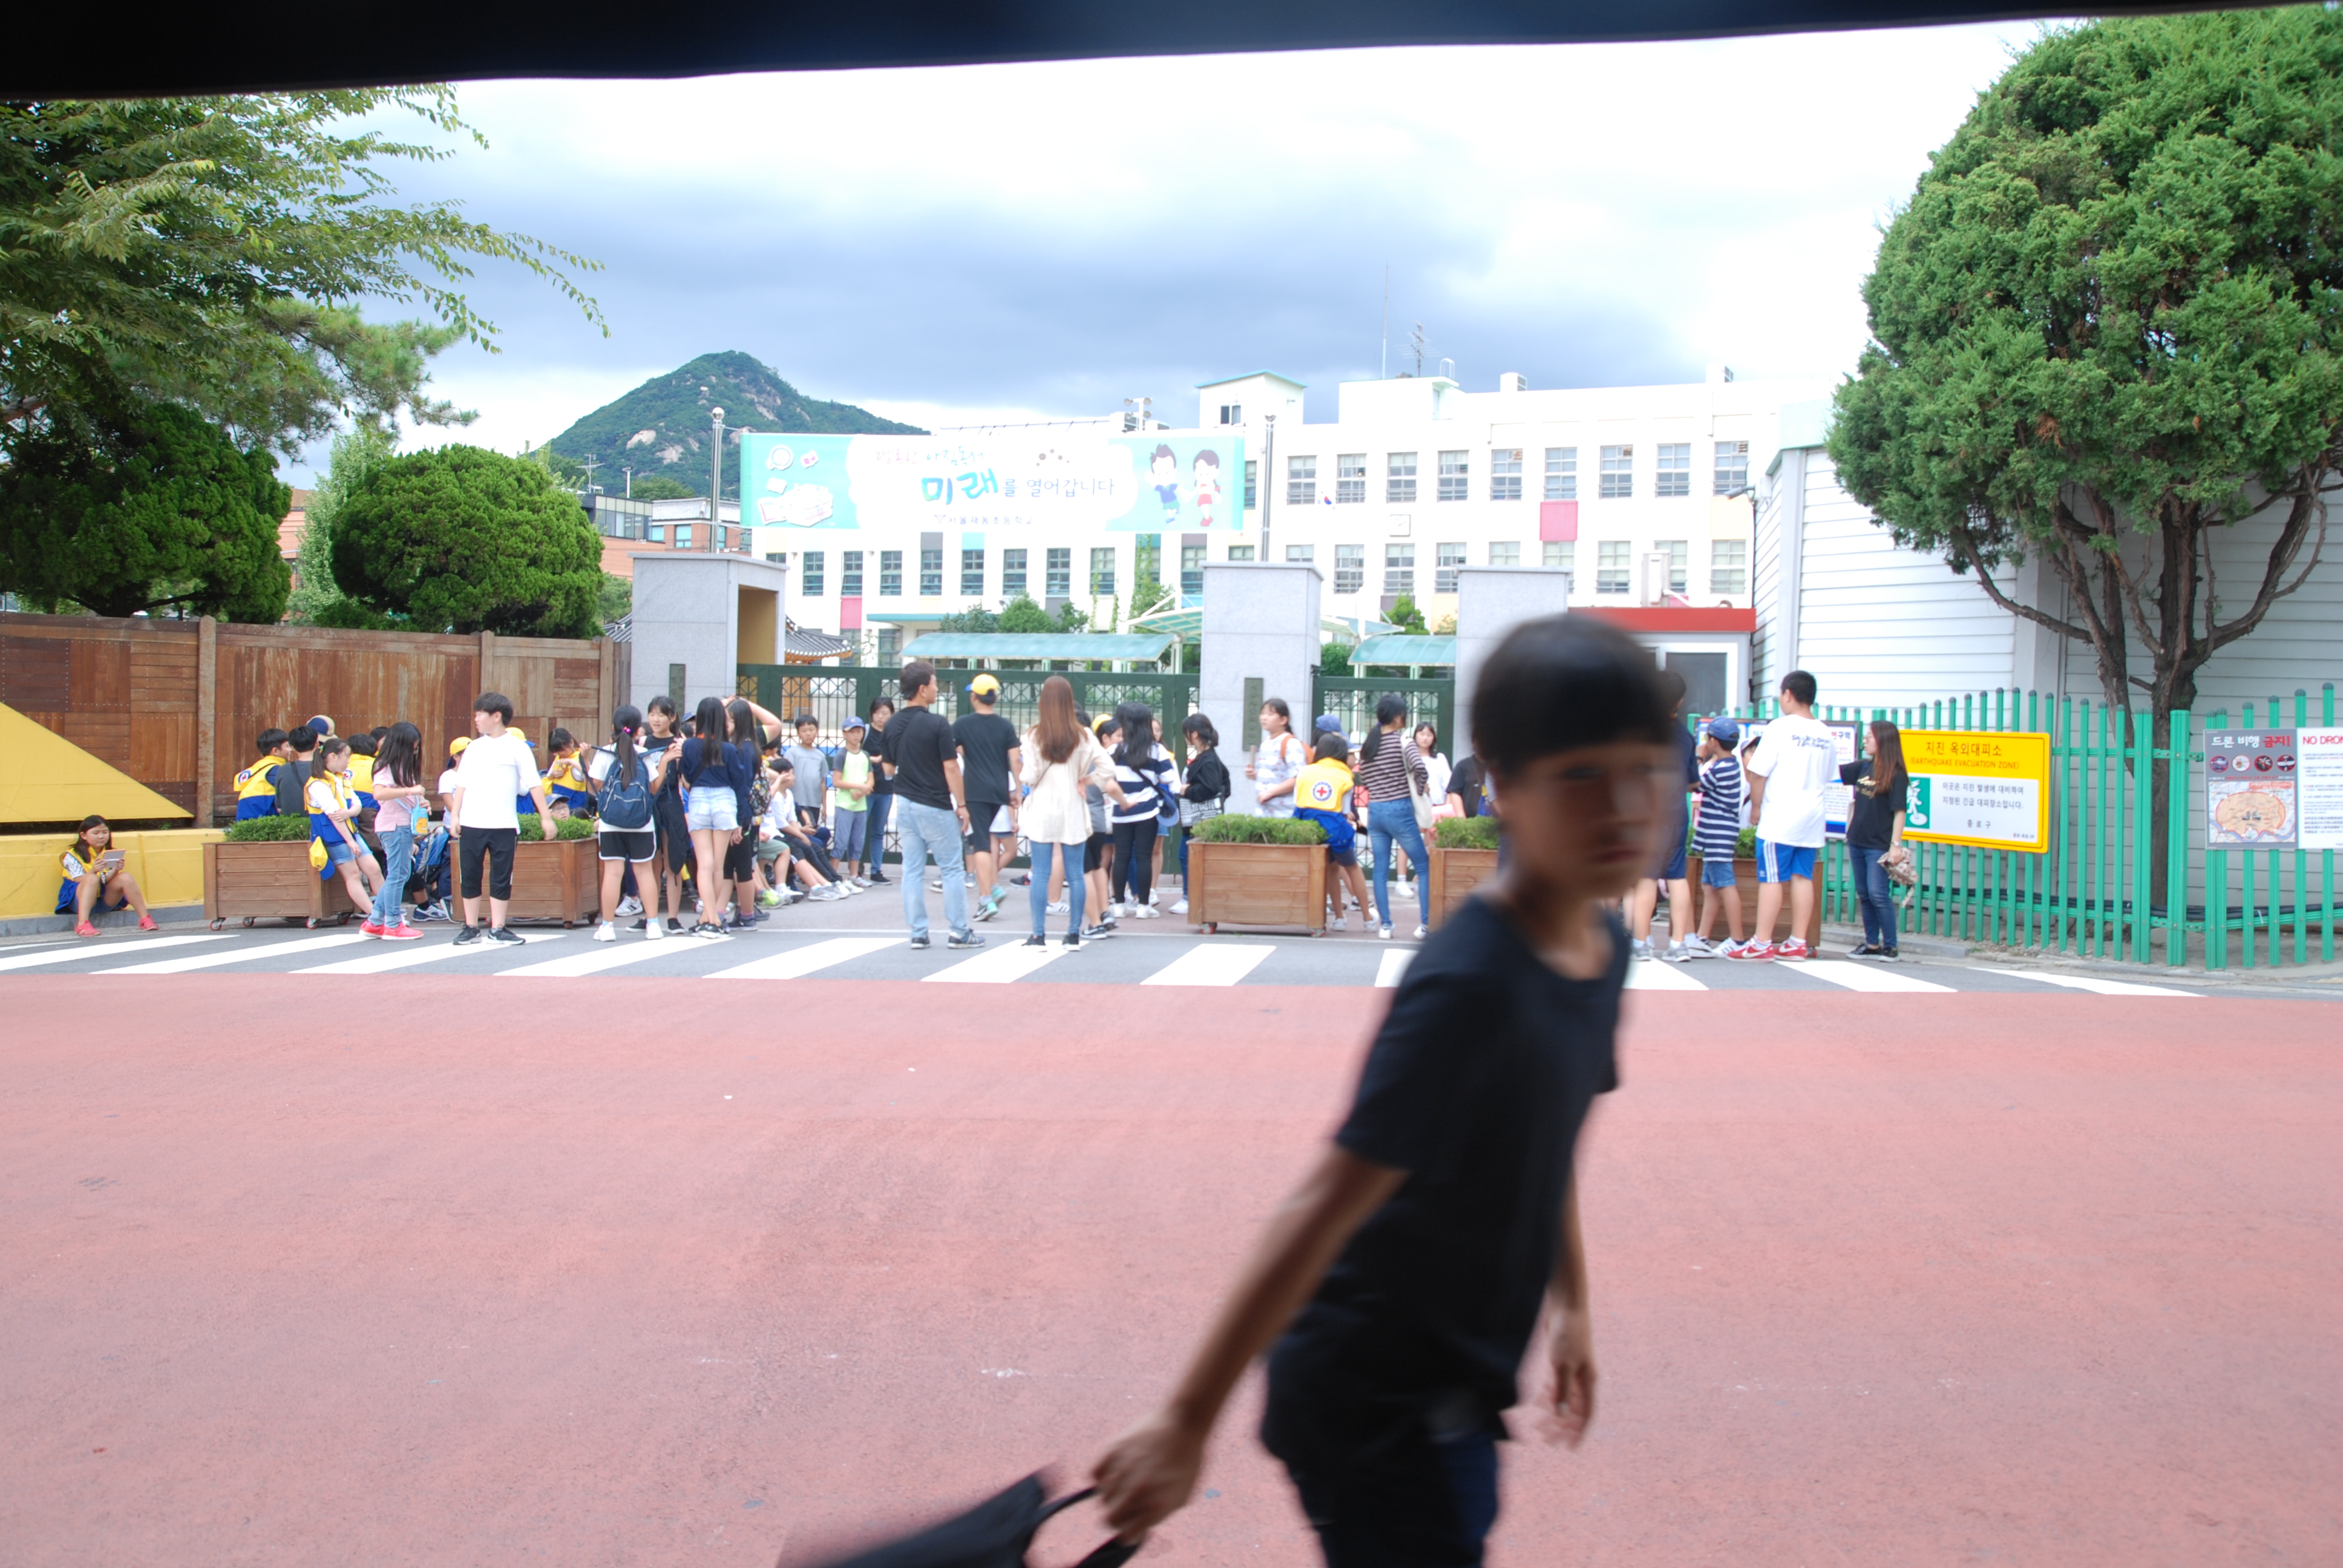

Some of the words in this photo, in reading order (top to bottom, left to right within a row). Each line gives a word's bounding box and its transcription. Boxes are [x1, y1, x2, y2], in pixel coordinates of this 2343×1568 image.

[920, 468, 1018, 506] 미래를
[1027, 478, 1116, 498] 열어갑니다
[1831, 731, 1851, 740] 연구역
[2211, 736, 2235, 748] 드론
[2238, 735, 2260, 748] 비행
[2263, 735, 2291, 748] 금지!
[2302, 736, 2318, 745] NO
[1926, 741, 1945, 755] 지진
[1950, 742, 2002, 757] 옥외대피소
[1910, 757, 1952, 767] (EARTHQUAKE
[1955, 759, 1996, 768] EVACUATION
[1998, 761, 2020, 770] ZONE)
[1942, 782, 1960, 791] 이곳은
[1962, 783, 1974, 792] 지진
[1977, 784, 1996, 793] 발생에
[1998, 785, 2024, 794] 대비하여
[1942, 796, 1960, 805] 지정된
[1962, 797, 1974, 806] 긴급
[1977, 799, 2024, 809] 대피장소입니다.
